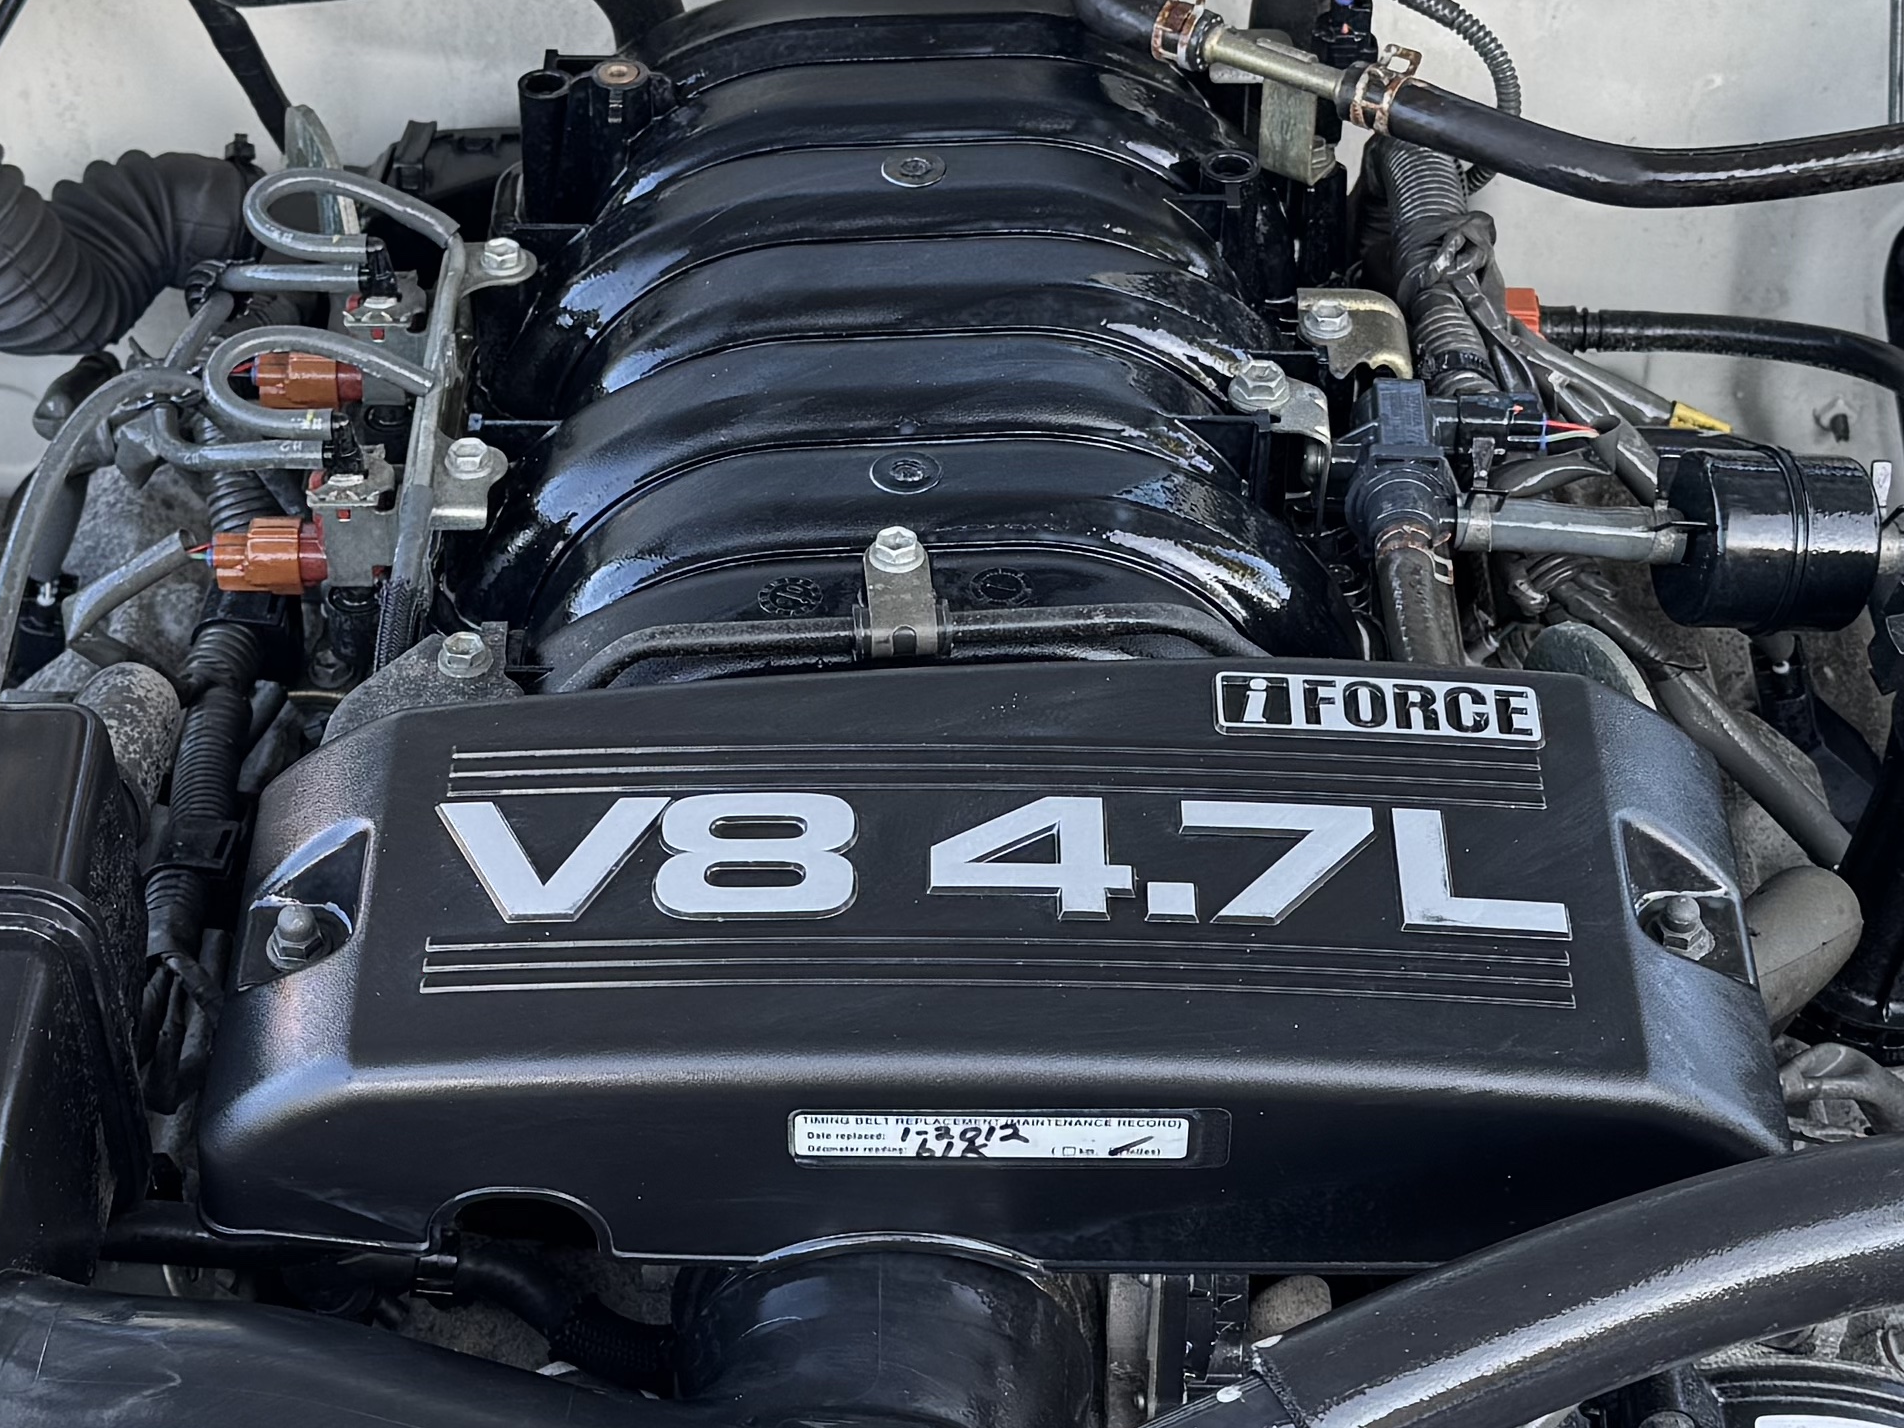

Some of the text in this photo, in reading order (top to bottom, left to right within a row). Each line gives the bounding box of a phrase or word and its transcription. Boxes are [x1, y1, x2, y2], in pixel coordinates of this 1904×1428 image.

[436, 792, 1572, 941] V8 4.7L
[802, 1116, 1183, 1129] TIMING BELT REPLACEMENT (MAINTENANCE RECORD)
[807, 1131, 886, 1142] Date replaced:
[807, 1145, 859, 1154] Odometer
